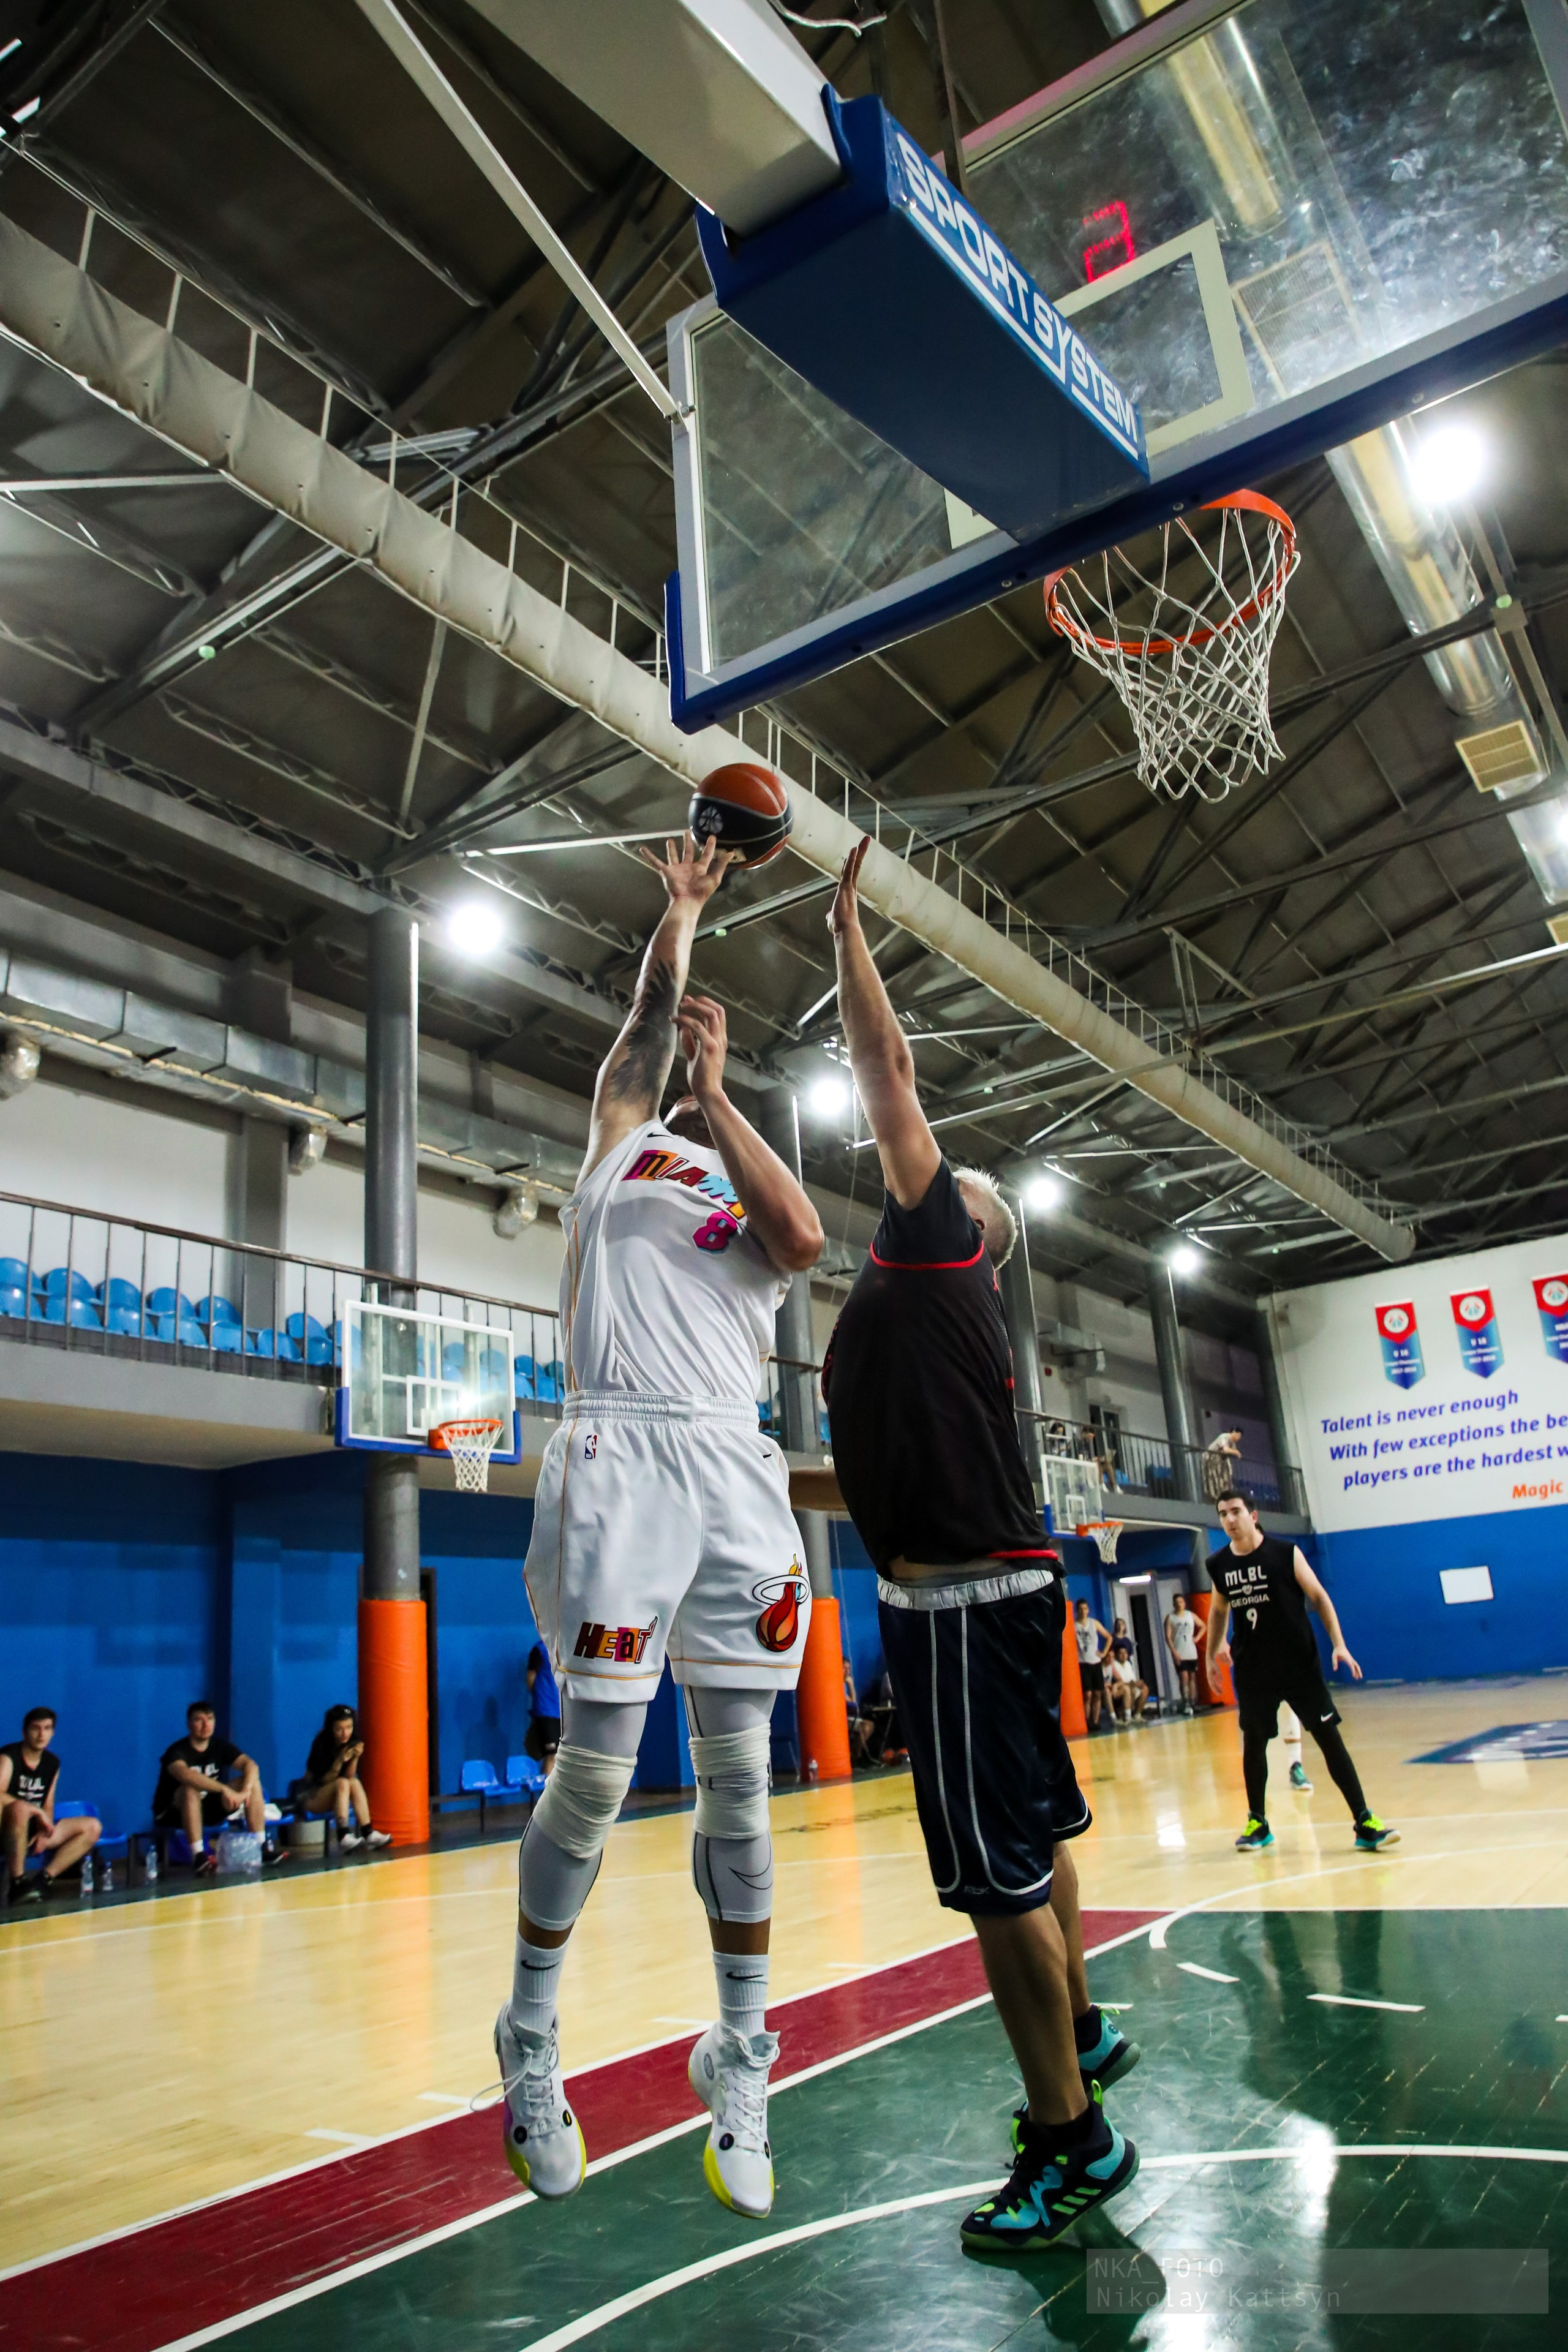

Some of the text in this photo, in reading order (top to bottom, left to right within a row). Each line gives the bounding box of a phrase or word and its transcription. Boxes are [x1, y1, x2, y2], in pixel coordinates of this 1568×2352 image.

[897, 133, 1138, 443] SPORT SYSTEM
[692, 1210, 738, 1254] 8
[1321, 1389, 1518, 1433] Talent is never enough
[1330, 1442, 1367, 1460] With
[1373, 1439, 1403, 1459] few
[1409, 1425, 1504, 1449] exceptions
[1511, 1418, 1539, 1434] the
[1343, 1468, 1408, 1491] players
[1414, 1463, 1442, 1477] are
[1447, 1457, 1475, 1472] the
[1482, 1445, 1552, 1468] hardest
[1512, 1479, 1563, 1500] Magic
[1225, 1565, 1267, 1586] MLBL
[1231, 1594, 1269, 1608] GEORGIA
[1246, 1608, 1257, 1630] 9
